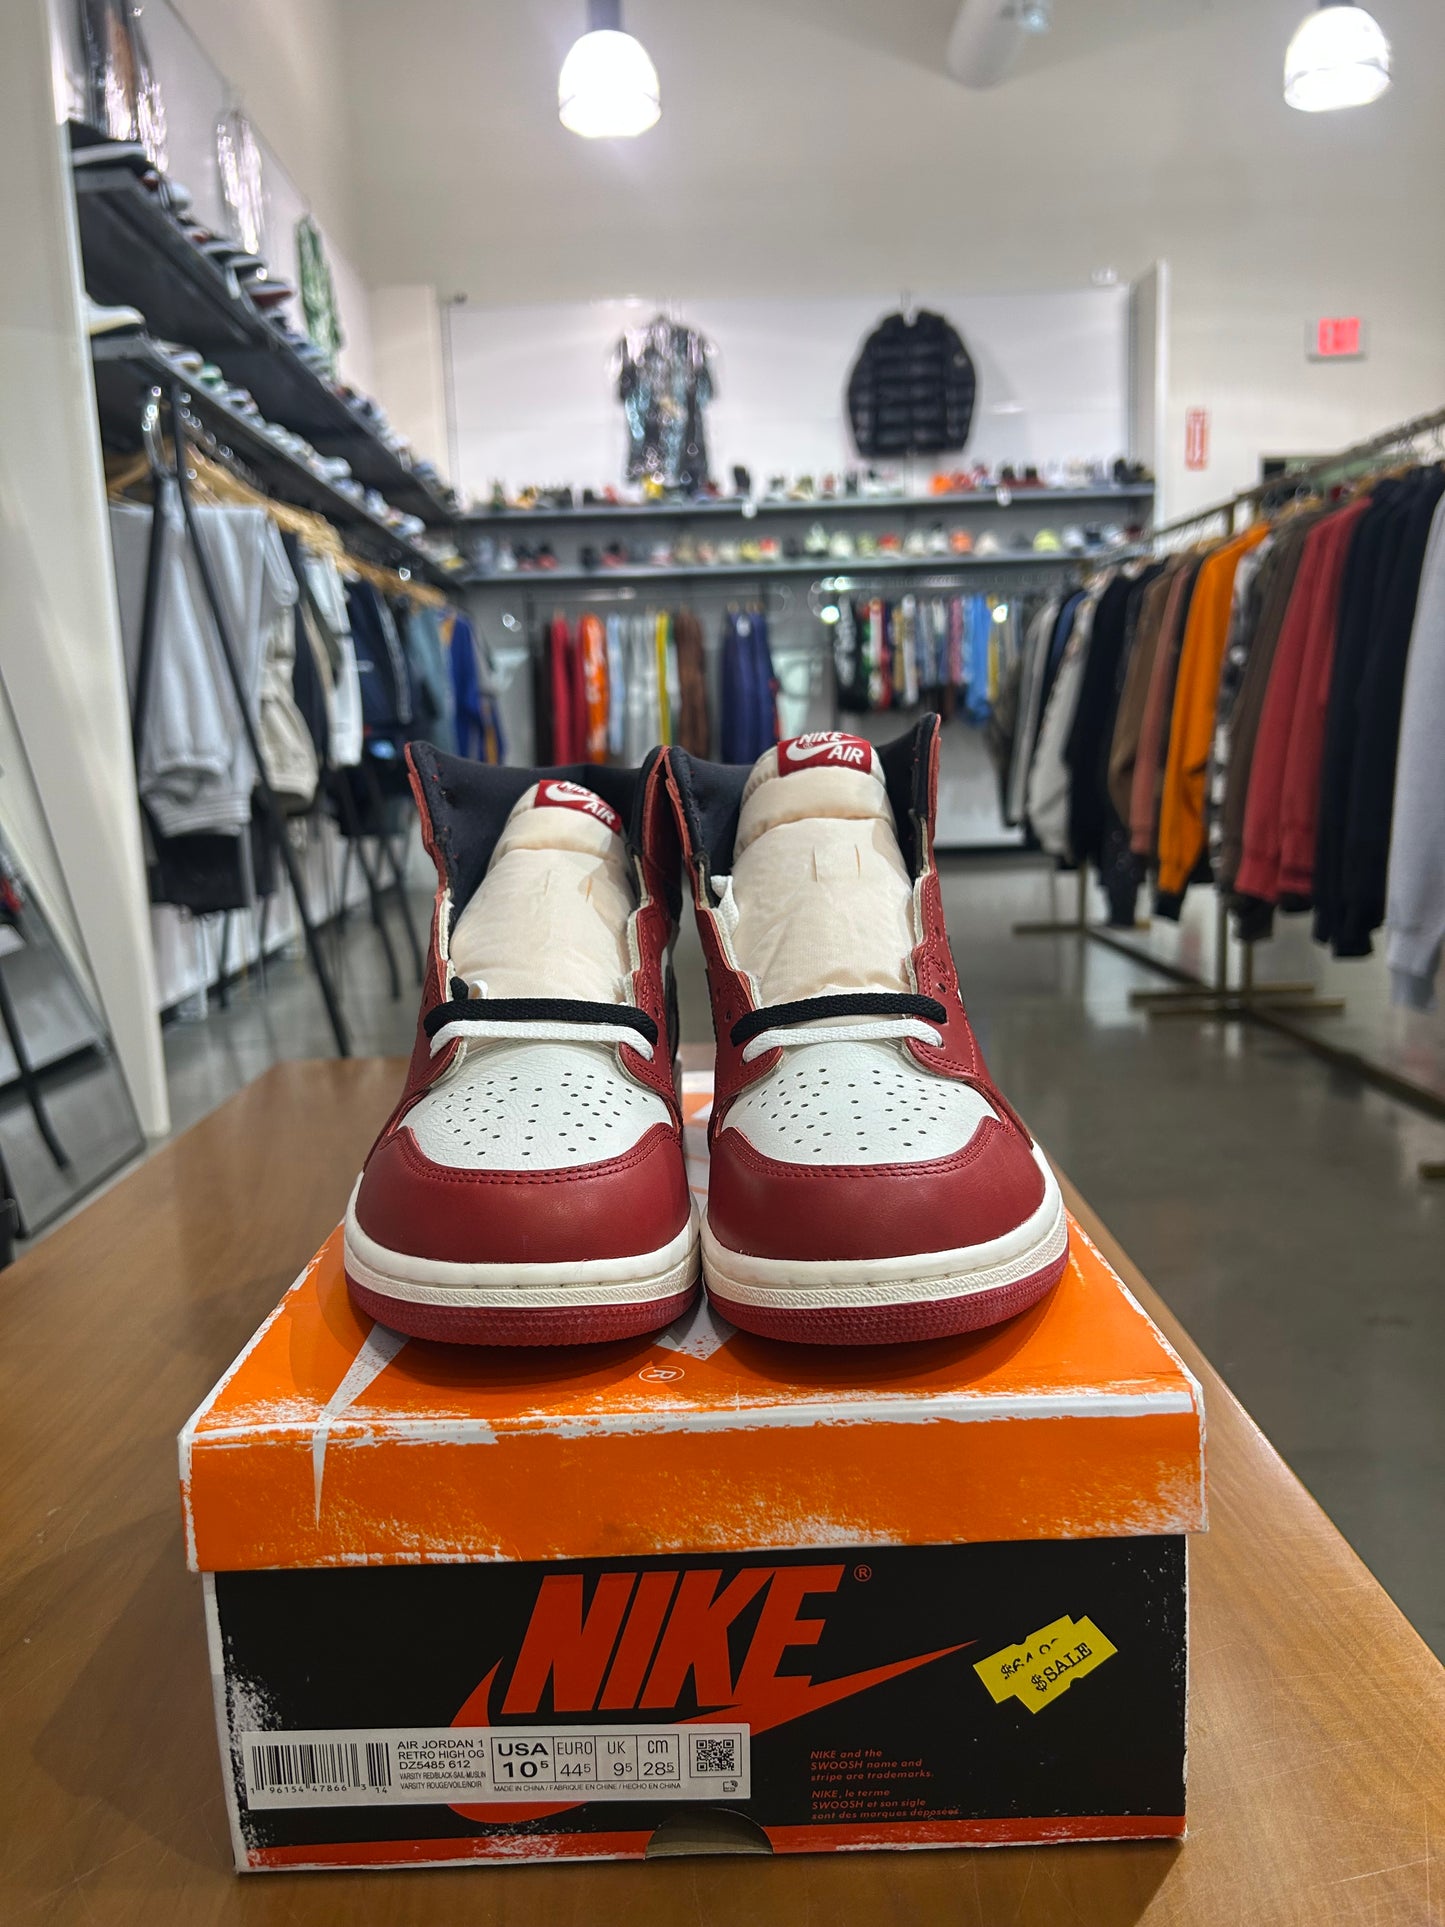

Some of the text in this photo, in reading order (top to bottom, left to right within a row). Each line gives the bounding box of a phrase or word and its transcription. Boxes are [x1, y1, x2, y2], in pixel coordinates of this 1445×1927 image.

[799, 731, 844, 744] NIKE
[827, 745, 864, 765] AIR
[559, 781, 600, 799] NIK
[582, 801, 616, 825] AIR
[501, 1564, 846, 1714] NIKE
[1031, 1642, 1093, 1692] $SALE
[397, 1739, 483, 1750] AIR JORDAN 1
[497, 1742, 549, 1756] USA
[557, 1741, 593, 1755] EURO
[607, 1741, 626, 1754] UK
[398, 1749, 485, 1760] RETRO HIGH OG
[810, 1748, 883, 1759] NIKE and the
[399, 1759, 471, 1770] DZ5485 612
[810, 1758, 923, 1771] SWOOSH name and
[400, 1771, 422, 1780] VARSITY
[810, 1773, 843, 1783] stripe
[846, 1772, 864, 1780] are
[269, 1786, 304, 1794] 96154
[312, 1784, 347, 1792] 47866
[400, 1781, 426, 1790] VARSITY
[622, 1782, 648, 1790] HECHO
[845, 1788, 855, 1797] le
[857, 1789, 891, 1797] terme
[811, 1800, 864, 1810] SWOOSH
[866, 1800, 878, 1808] et
[901, 1798, 926, 1809] sigle
[811, 1812, 836, 1820] sont
[838, 1810, 857, 1819] des
[860, 1810, 907, 1819] marques
